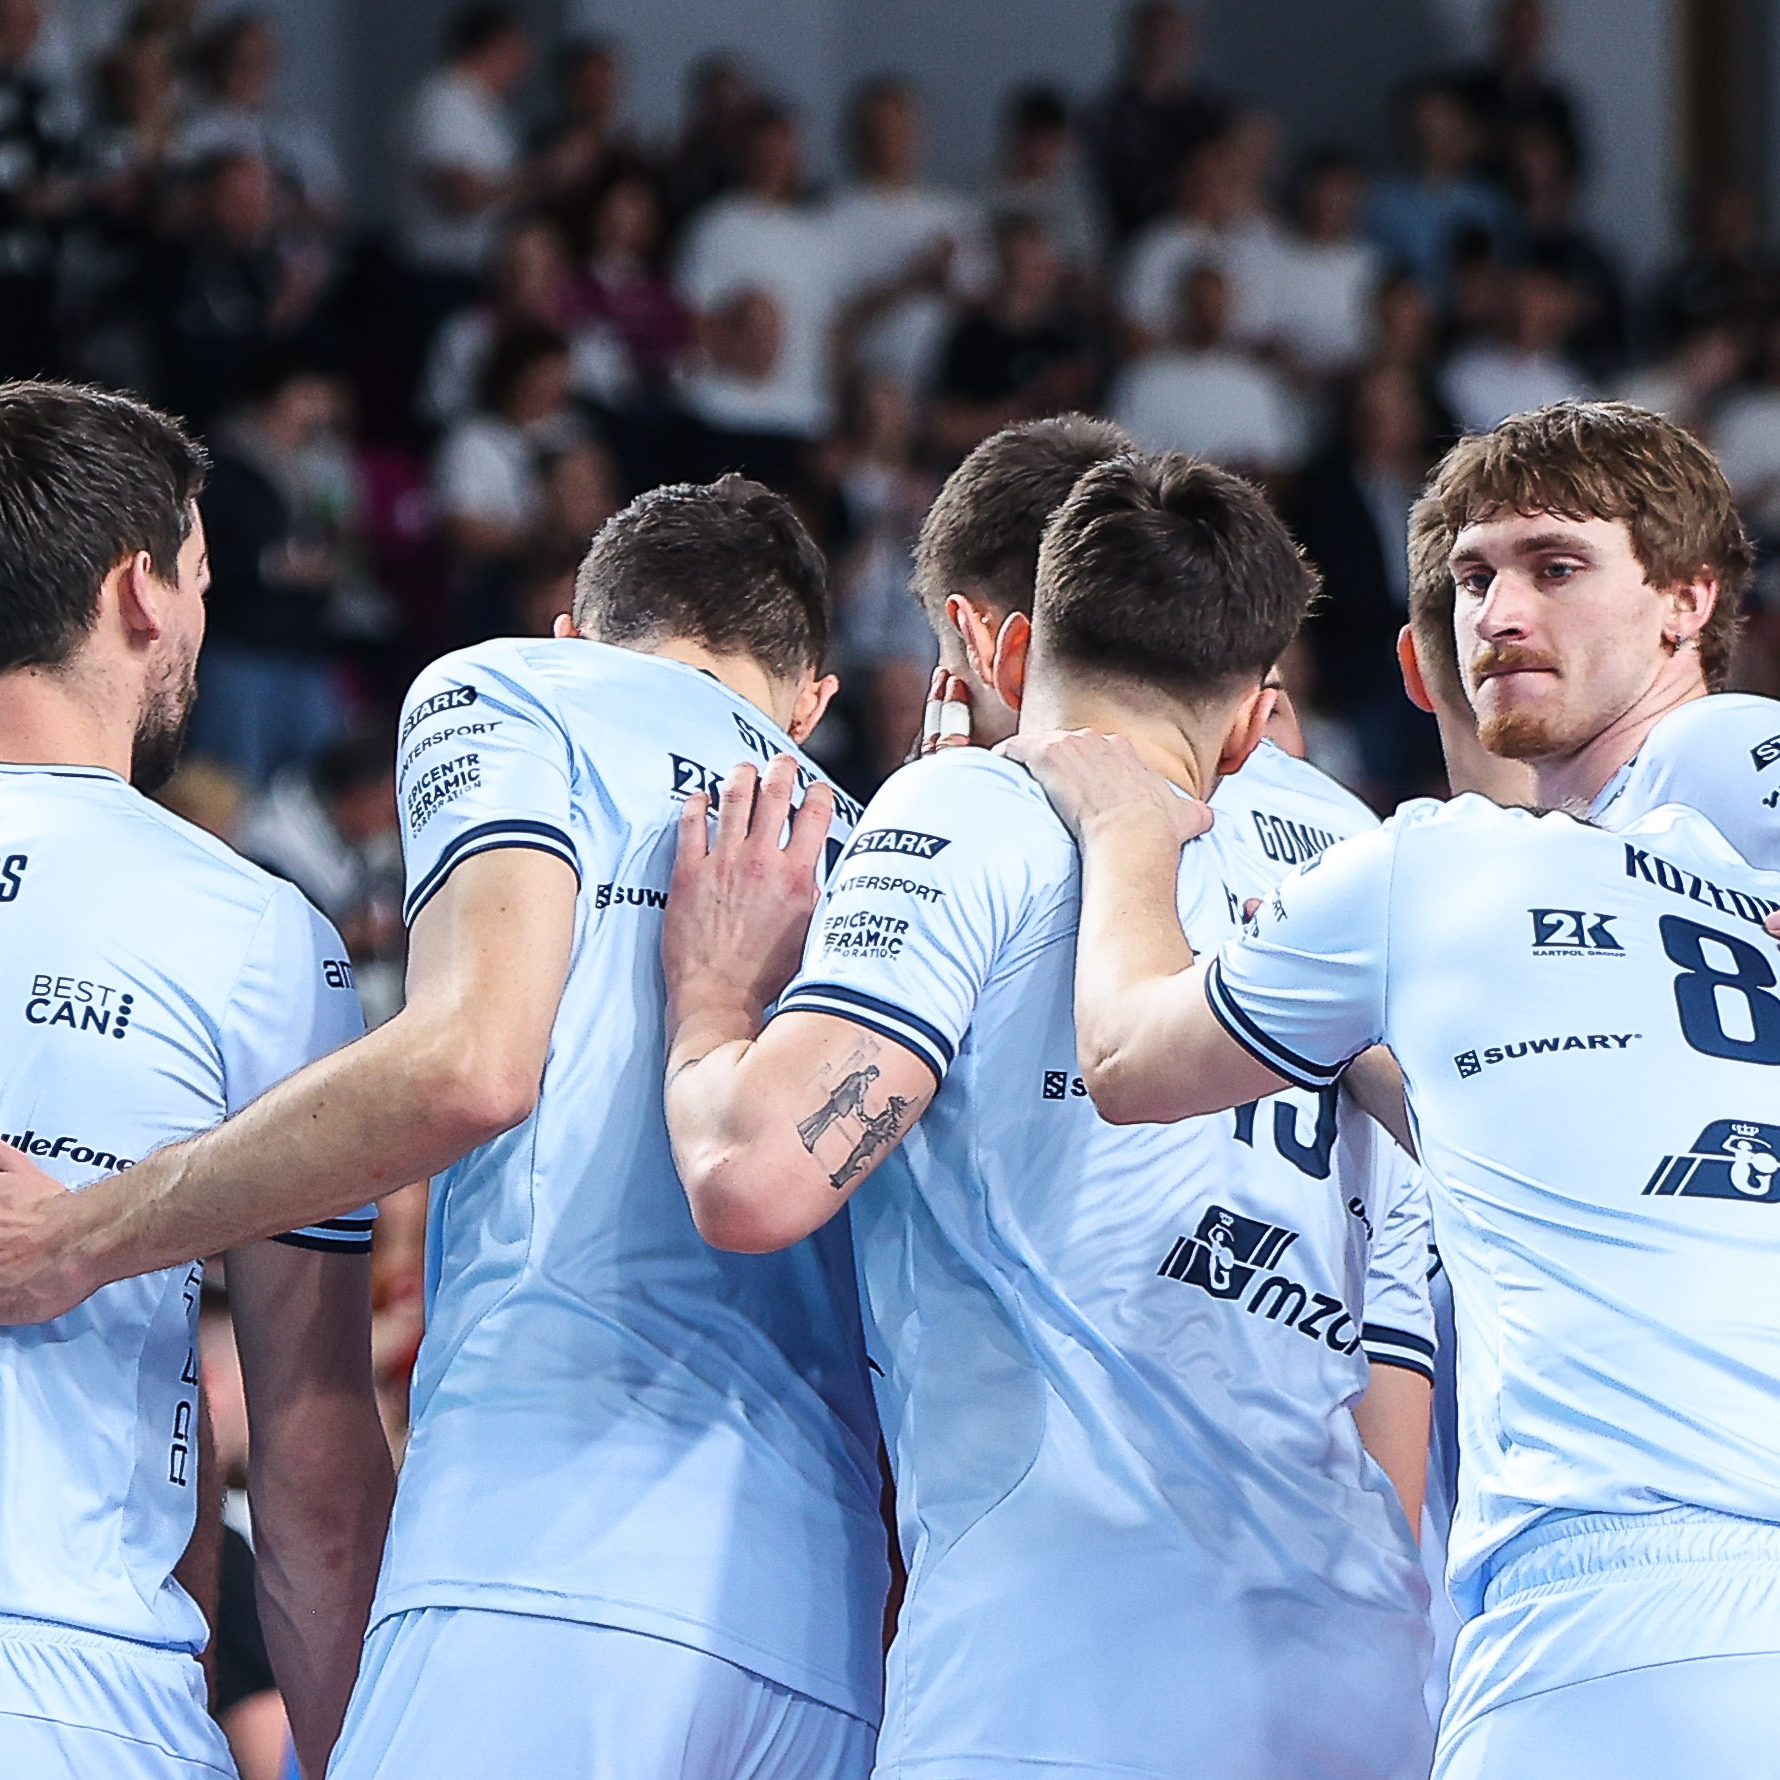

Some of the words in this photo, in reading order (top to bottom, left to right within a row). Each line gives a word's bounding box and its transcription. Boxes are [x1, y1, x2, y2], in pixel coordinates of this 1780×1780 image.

[853, 831, 939, 857] STARK
[824, 928, 904, 955] ERAMIC
[1526, 908, 1625, 951] 2K
[31, 974, 116, 1008] BEST
[24, 997, 111, 1036] CAN
[1483, 1032, 1633, 1065] SUWARY
